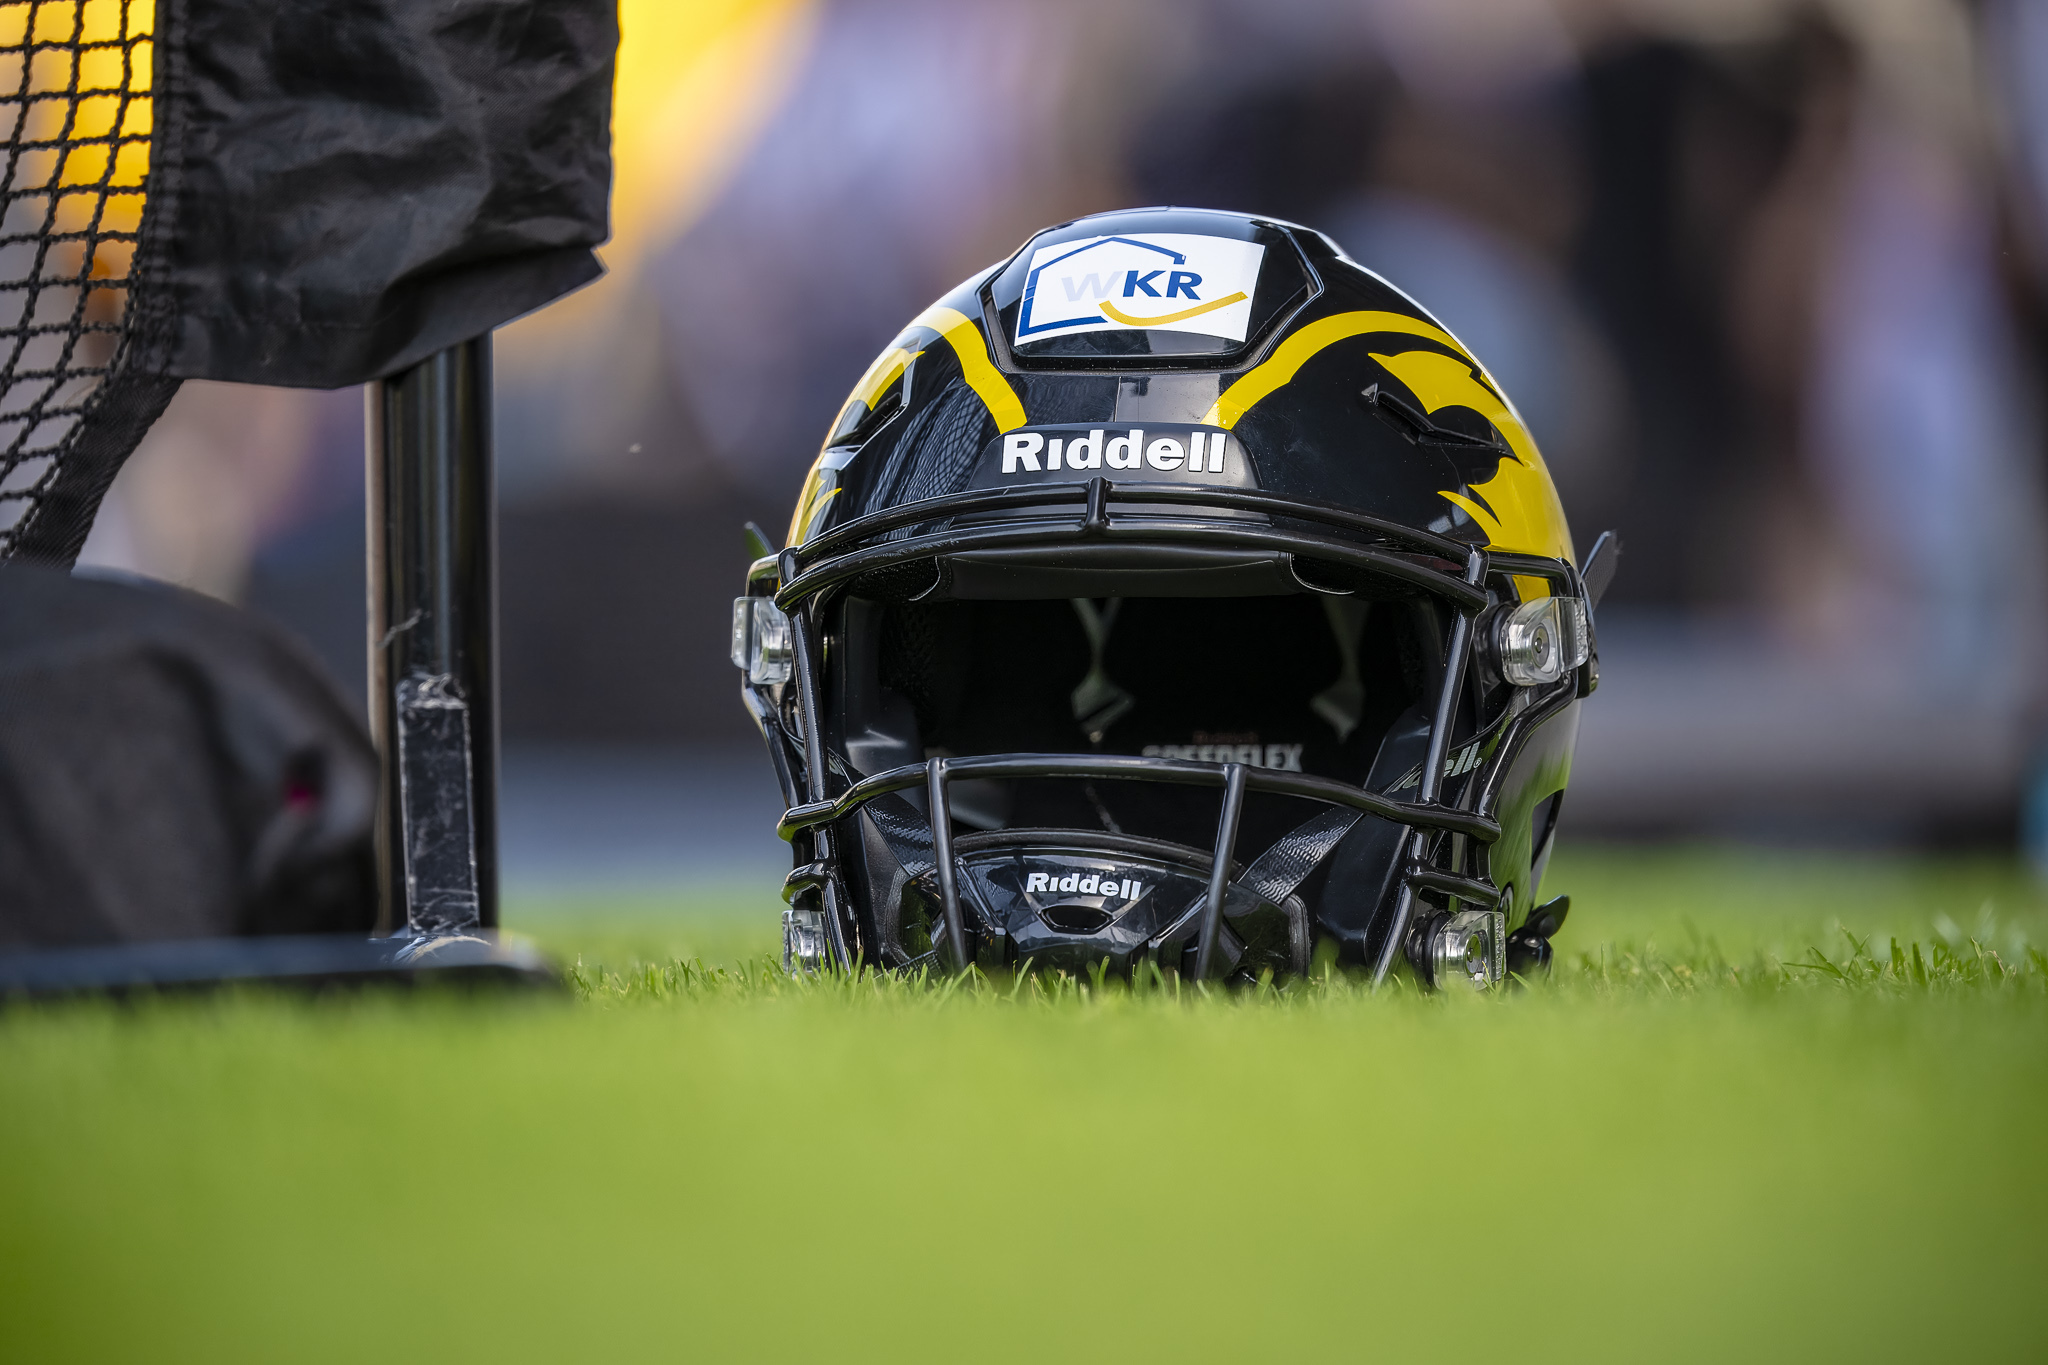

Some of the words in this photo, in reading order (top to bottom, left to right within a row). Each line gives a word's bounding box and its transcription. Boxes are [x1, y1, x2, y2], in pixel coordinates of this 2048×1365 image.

[1061, 270, 1203, 301] WKR
[1001, 429, 1227, 474] Riddell
[1026, 872, 1142, 900] Riddell
